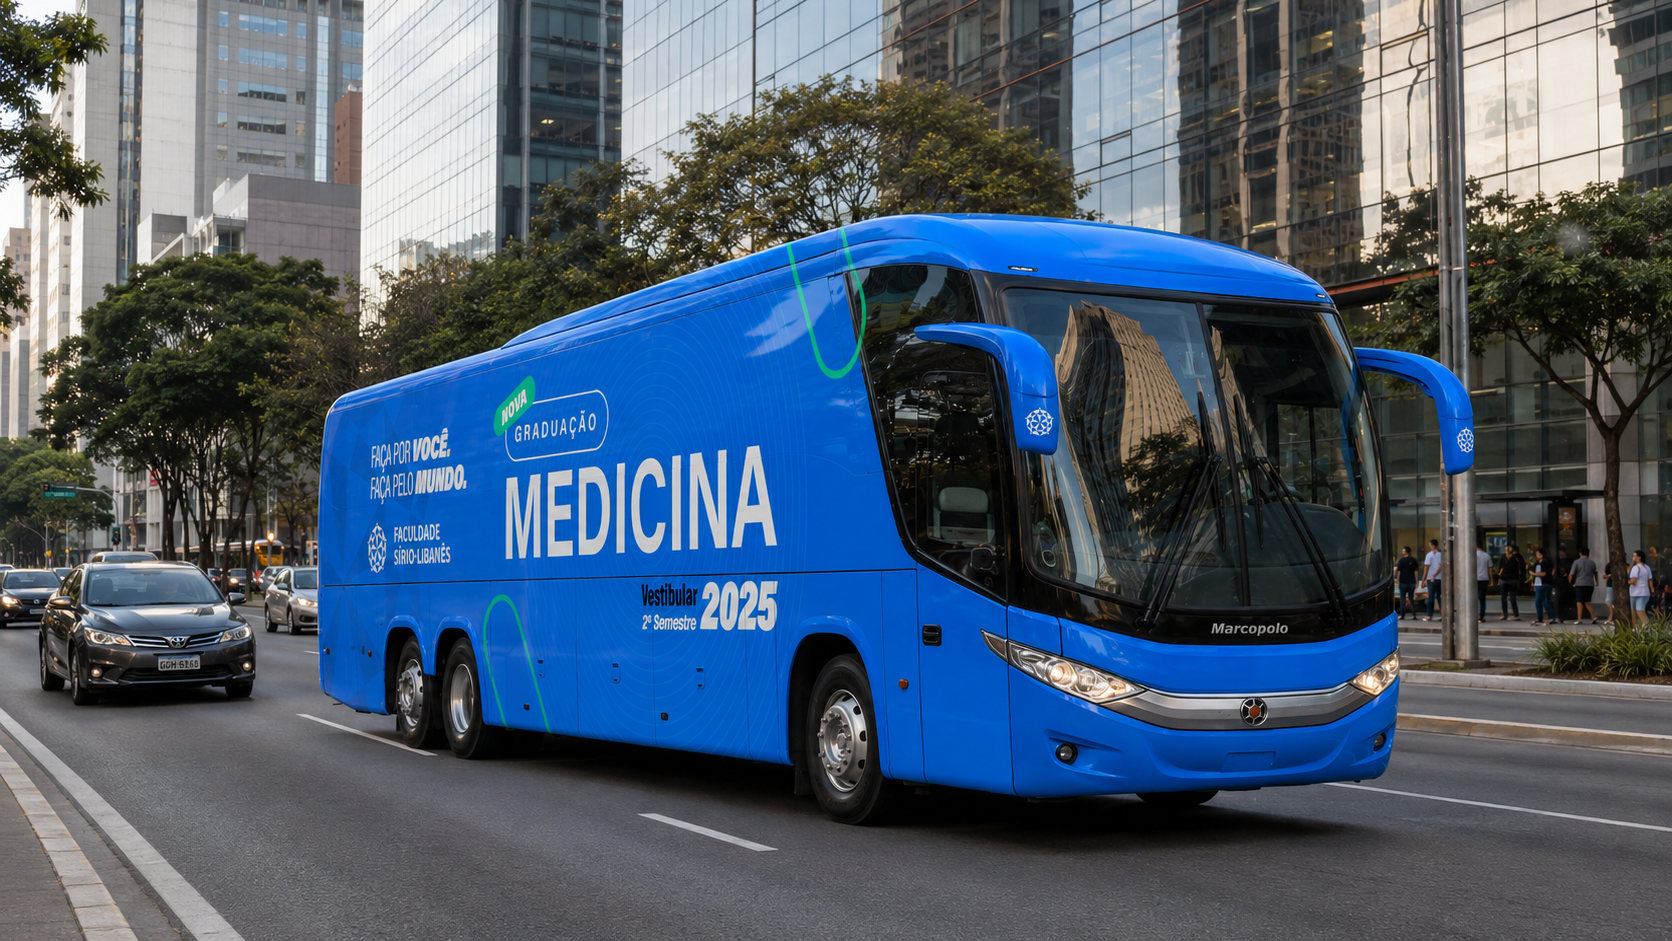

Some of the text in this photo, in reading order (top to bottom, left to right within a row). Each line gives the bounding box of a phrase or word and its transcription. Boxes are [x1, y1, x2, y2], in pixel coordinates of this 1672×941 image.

[501, 389, 528, 426] NOVA
[514, 409, 597, 443] GRADUAÇÃO
[371, 427, 451, 473] FAÇA POR VOCÊ.
[370, 464, 467, 505] FAÇA PELO MUNDO.
[505, 445, 778, 559] MEDICINA
[393, 523, 441, 543] FACULDADE
[641, 582, 698, 607] Vestibular
[700, 580, 778, 632] 2025
[653, 613, 697, 631] Semestre
[1211, 622, 1289, 637] Marcopolo
